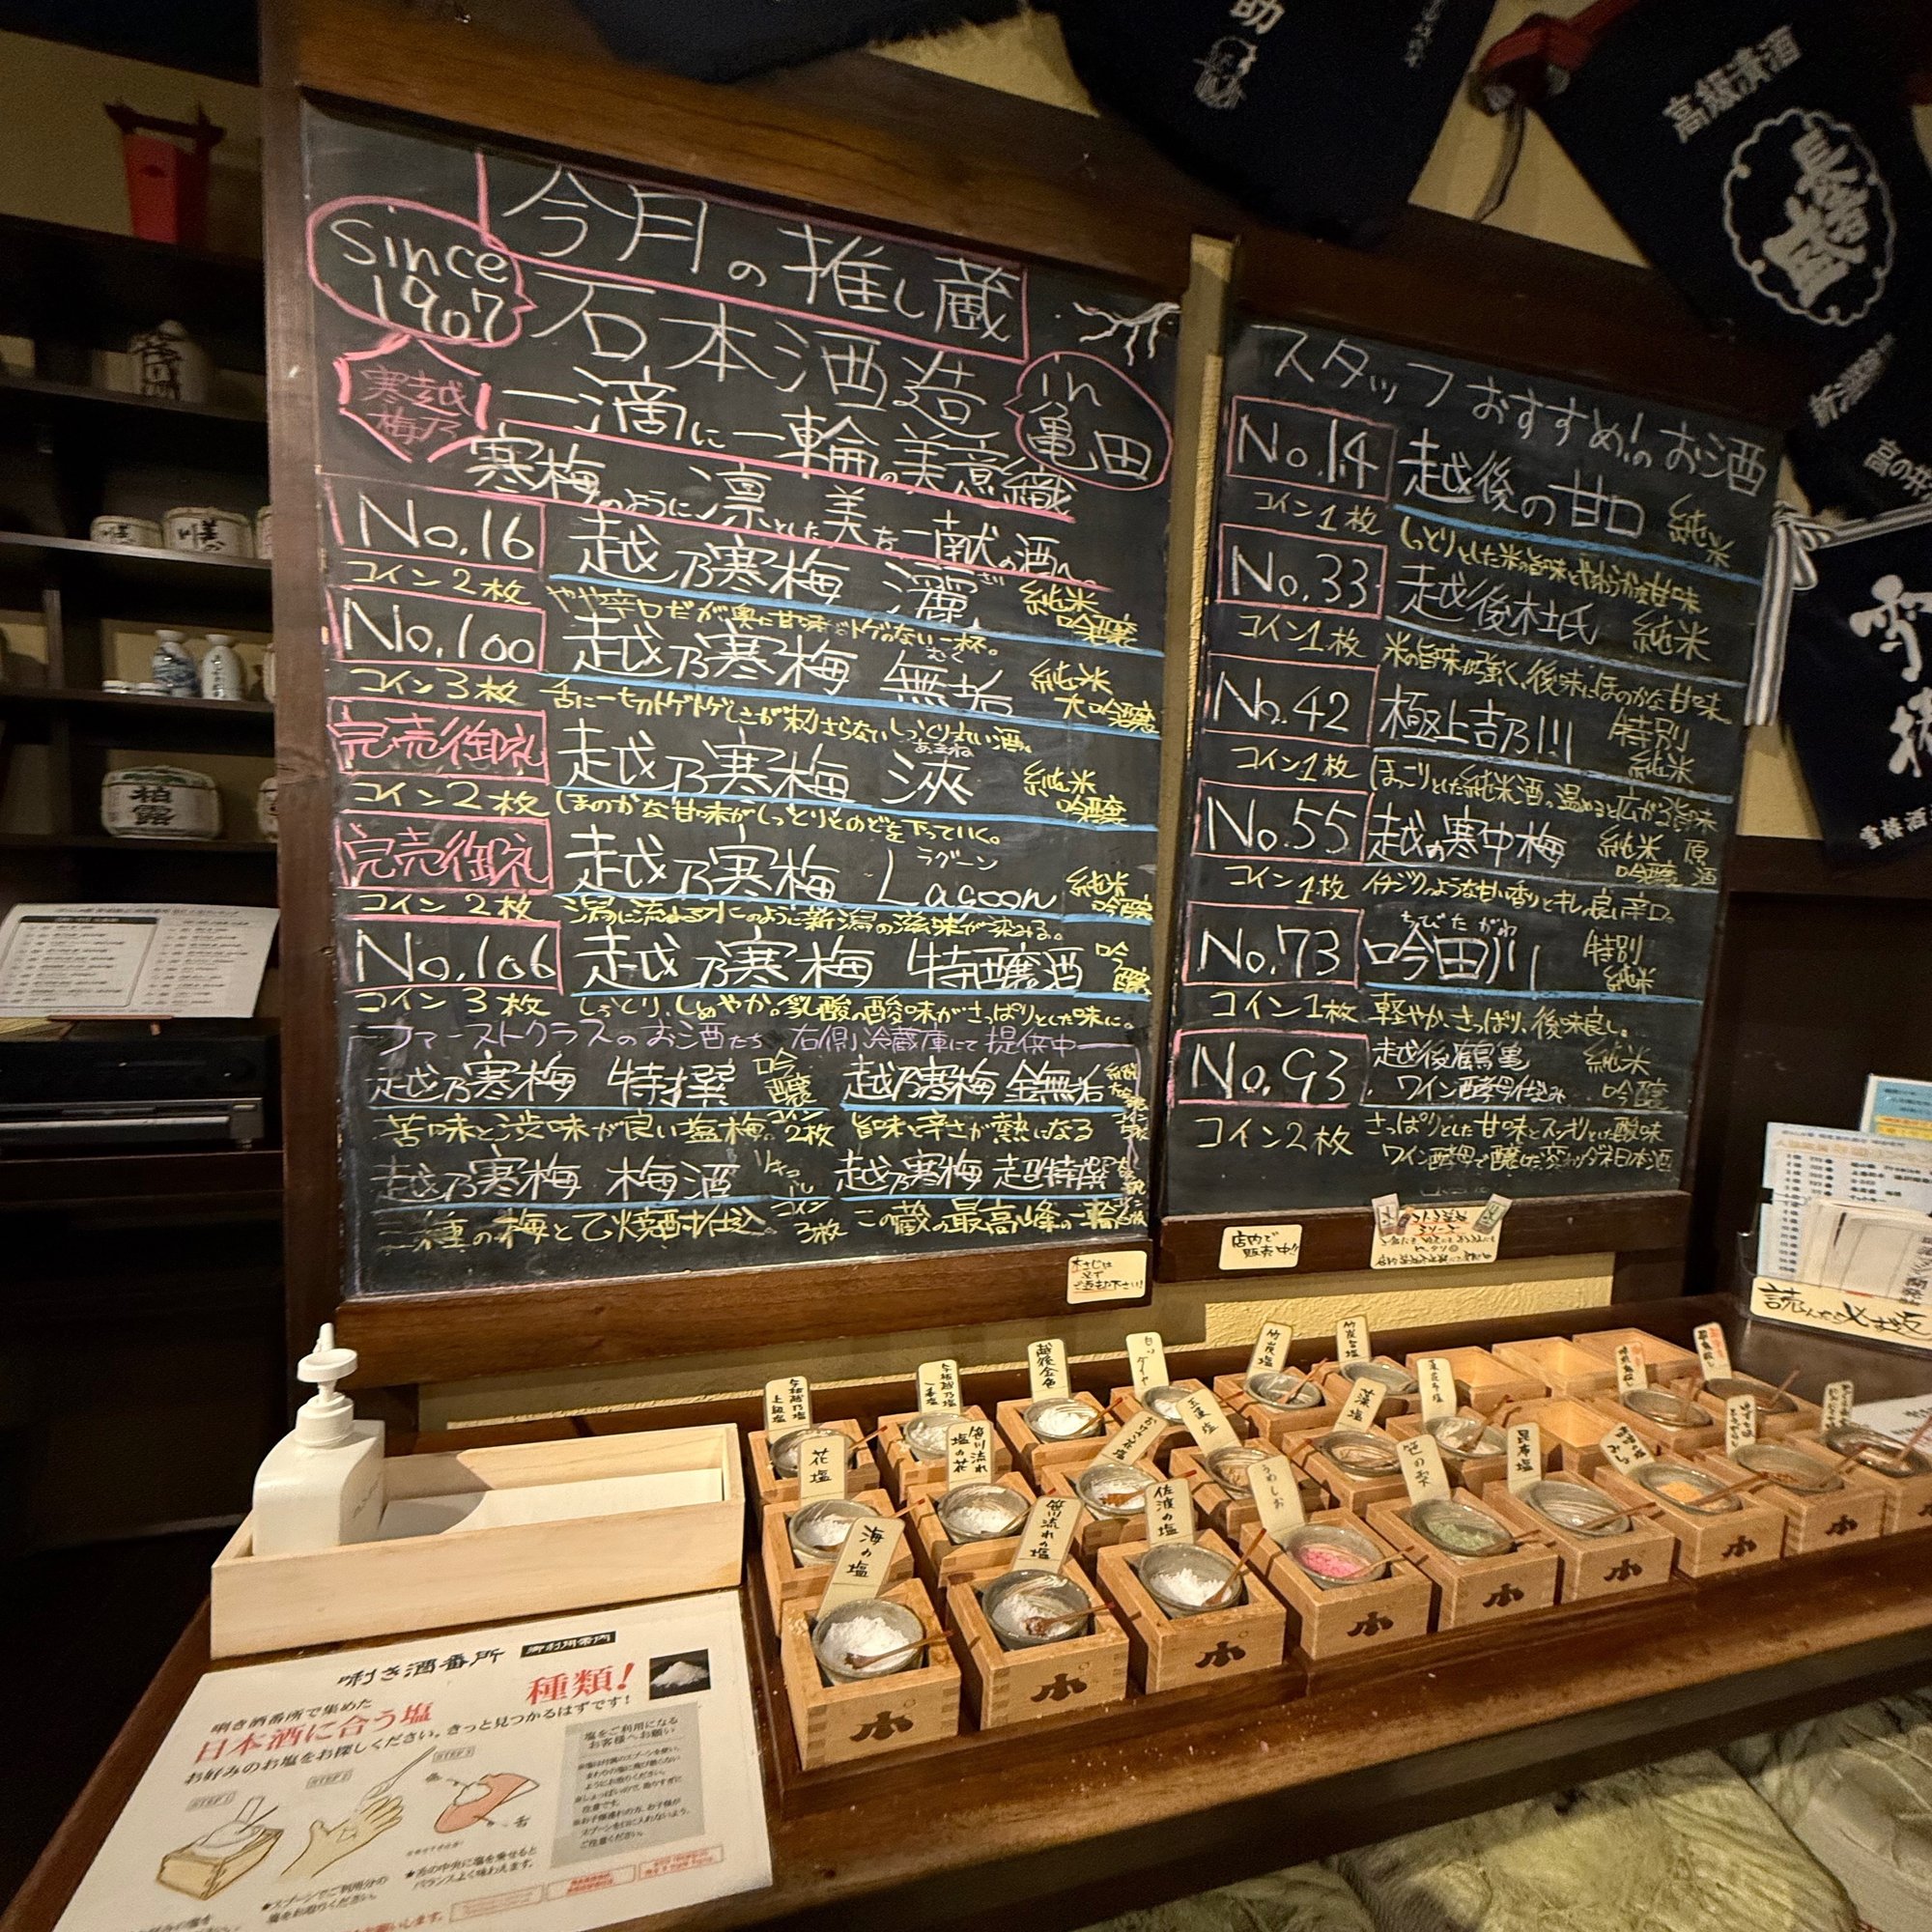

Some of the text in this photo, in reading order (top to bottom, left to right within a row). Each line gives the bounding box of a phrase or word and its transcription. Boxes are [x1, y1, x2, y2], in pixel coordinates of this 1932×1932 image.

[329, 204, 509, 284] Since
[502, 164, 1021, 343] 今月の推し蔵
[373, 274, 505, 342] 1907
[529, 270, 1001, 440] 石本酒造
[1237, 413, 1380, 489] No.14
[359, 493, 535, 560] No.16
[569, 508, 850, 607] 越乃寒梅
[1231, 543, 1371, 610] No.33
[342, 596, 536, 665] No.100
[562, 611, 859, 696] 越乃寒梅
[1213, 669, 1350, 734] No.42
[556, 718, 855, 813] 越乃寒梅
[1207, 795, 1357, 855] No.55
[565, 823, 840, 904] 越乃寒梅
[356, 929, 558, 983] No.106
[573, 923, 876, 991] 越乃寒梅
[1197, 925, 1341, 976] No.73
[365, 1049, 577, 1105] 越乃寒梅
[842, 1053, 1001, 1106] 越乃寒梅
[1190, 1040, 1350, 1101] No.93
[369, 1144, 742, 1204] 越乃寒梅 梅酒
[834, 1148, 983, 1195] 越乃寒梅
[810, 1447, 832, 1484] 花塩
[950, 1434, 970, 1473] 塩の花
[1029, 1498, 1065, 1560] 笹川流れの塩
[1153, 1486, 1179, 1537] 佐渡の塩
[846, 1524, 885, 1578] 海の塩
[194, 1701, 434, 1765] 日本酒に合う塩
